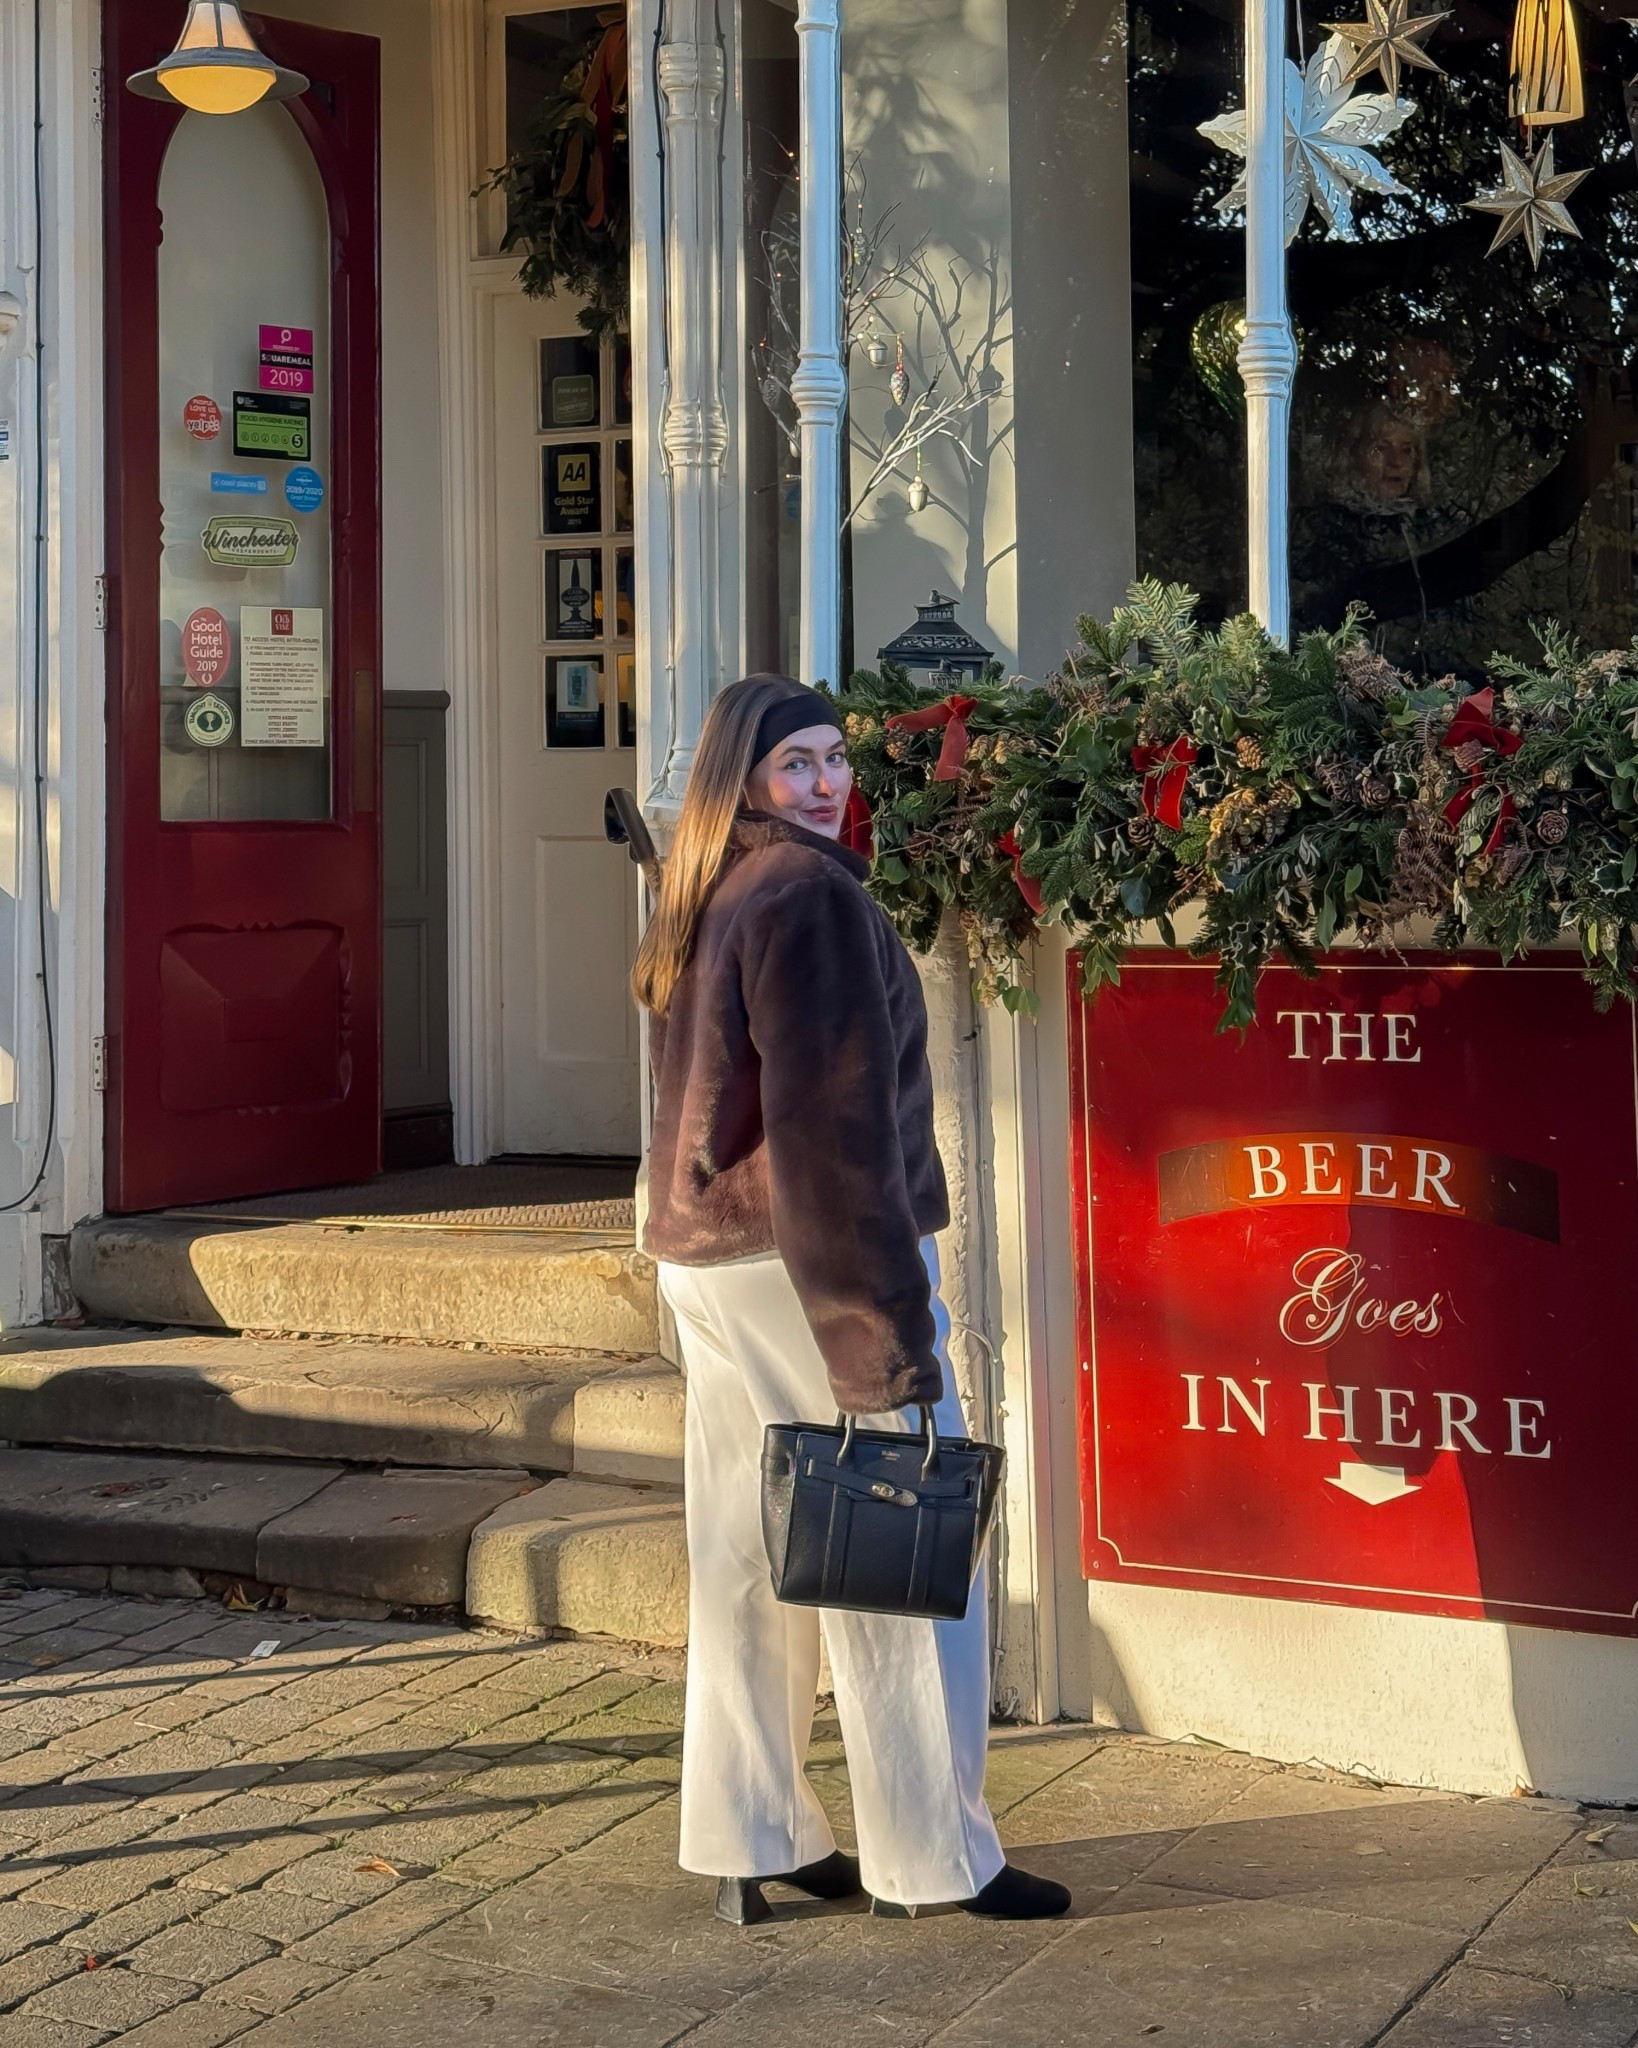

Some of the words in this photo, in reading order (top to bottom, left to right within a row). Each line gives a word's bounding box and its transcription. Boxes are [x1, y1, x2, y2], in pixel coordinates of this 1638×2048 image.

[269, 369, 304, 387] 2019
[187, 419, 209, 432] yelp
[240, 414, 259, 422] FOOD
[260, 416, 282, 424] HYGIENE
[284, 418, 304, 426] RATING
[293, 435, 301, 447] 5
[561, 461, 586, 482] AA
[554, 496, 575, 506] Gold
[576, 496, 594, 505] Star
[560, 506, 589, 515] Award
[202, 527, 299, 549] Winchester
[190, 620, 222, 632] Good
[191, 633, 222, 645] Hotel
[190, 645, 223, 658] Guide
[196, 660, 217, 672] 2019
[1276, 1011, 1421, 1065] THE
[1242, 1142, 1462, 1210] BEER
[1279, 1247, 1440, 1346] Goes
[1180, 1373, 1272, 1437] IN
[1301, 1382, 1551, 1459] HERE
